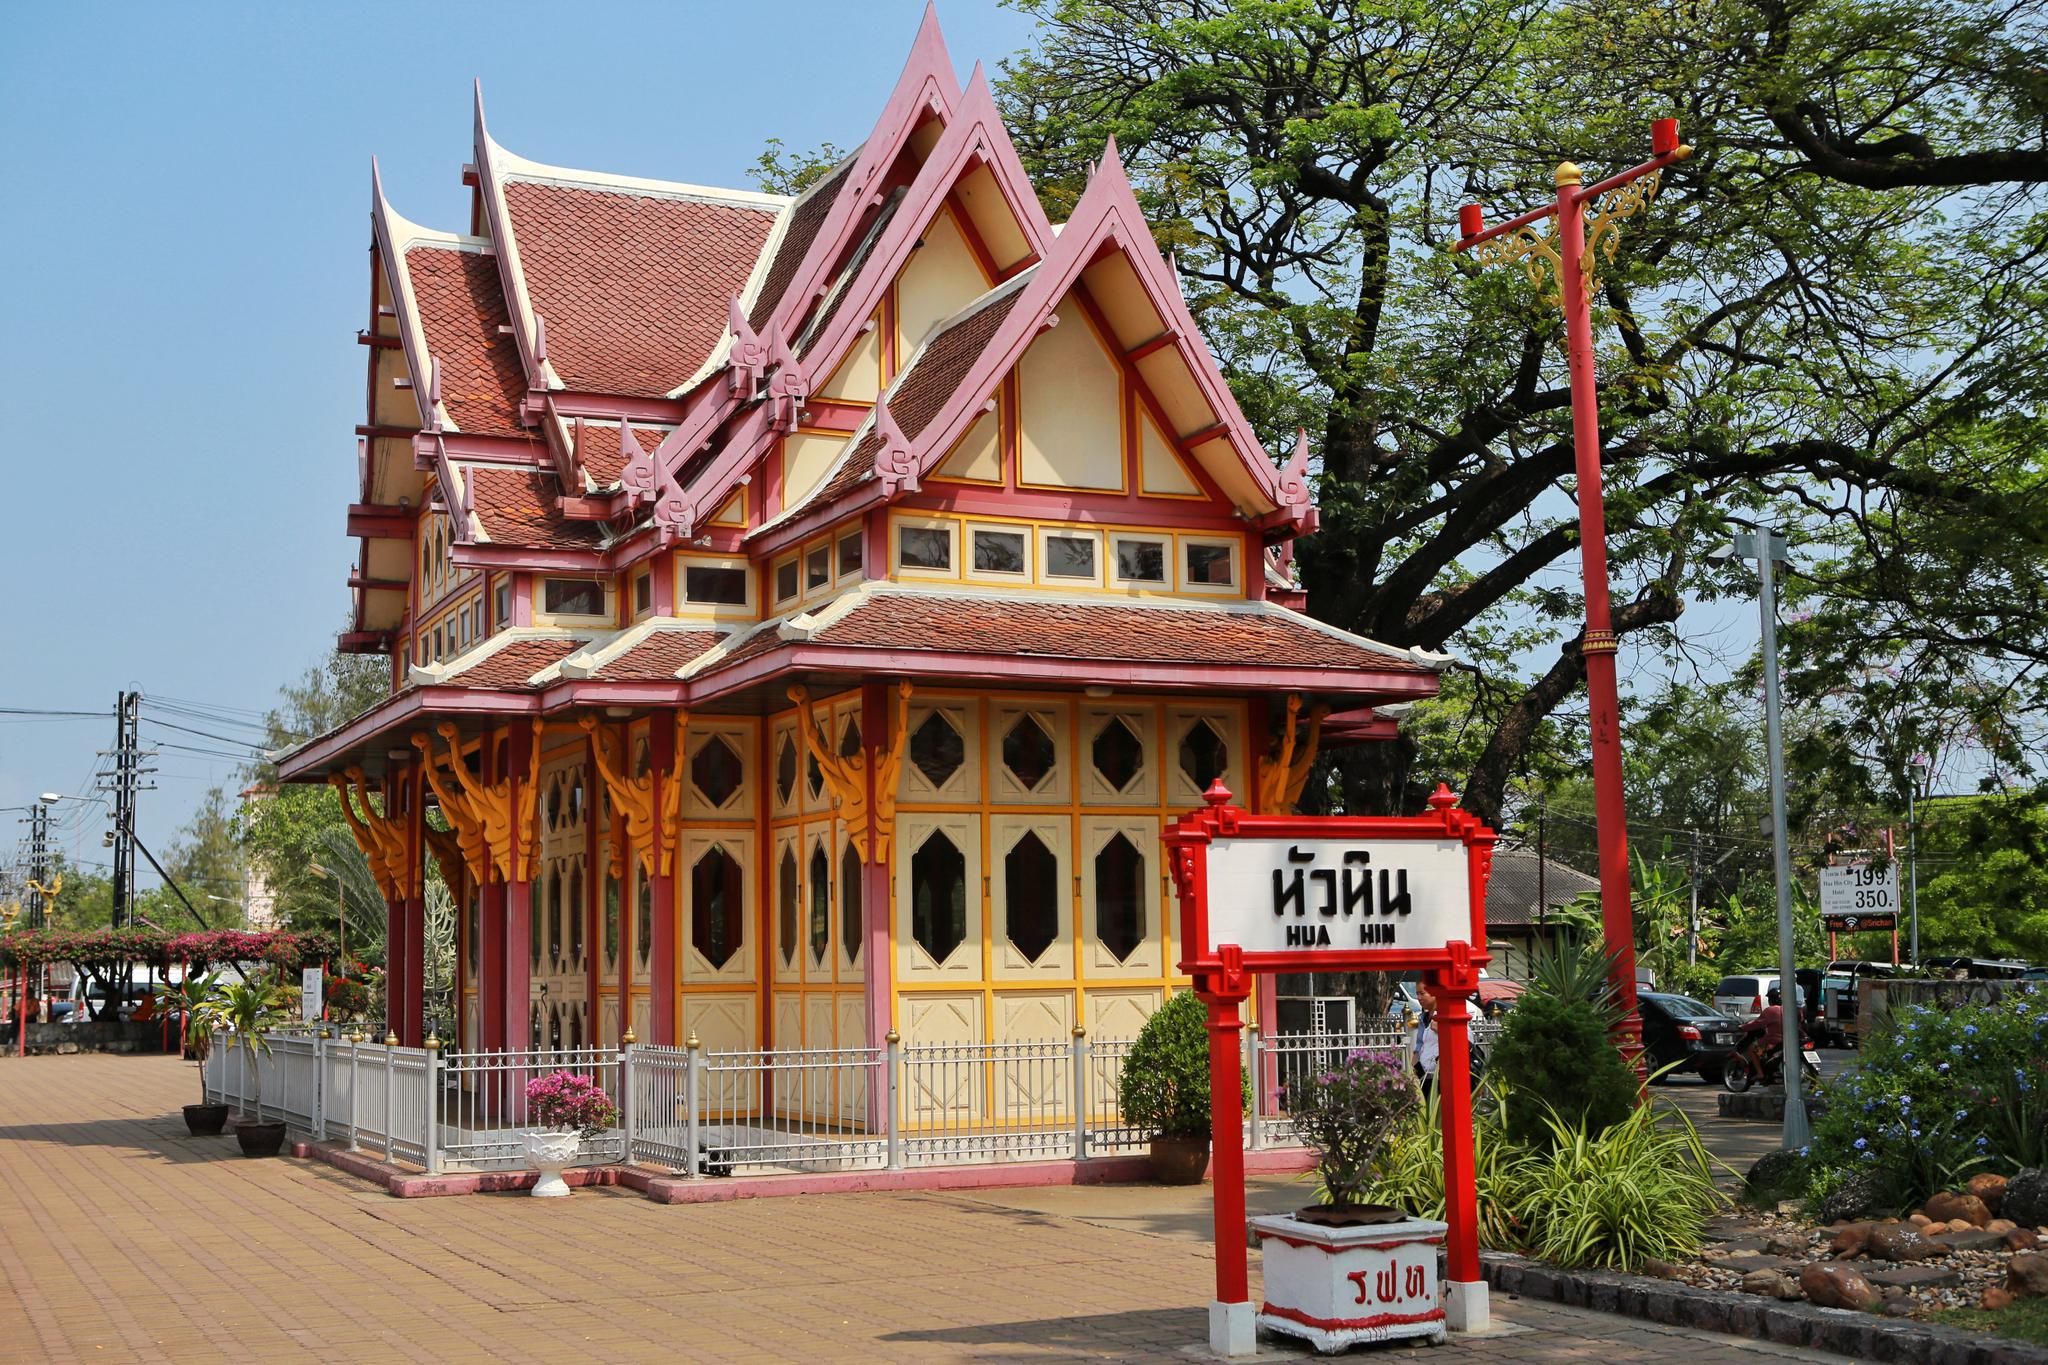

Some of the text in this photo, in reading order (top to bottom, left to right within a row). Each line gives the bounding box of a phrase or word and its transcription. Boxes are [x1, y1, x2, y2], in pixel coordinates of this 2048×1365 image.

[1272, 845, 1412, 916] หัวหิน
[1286, 923, 1396, 946] HUA HIN
[1347, 1259, 1431, 1305] ร.ฟ.ท.
